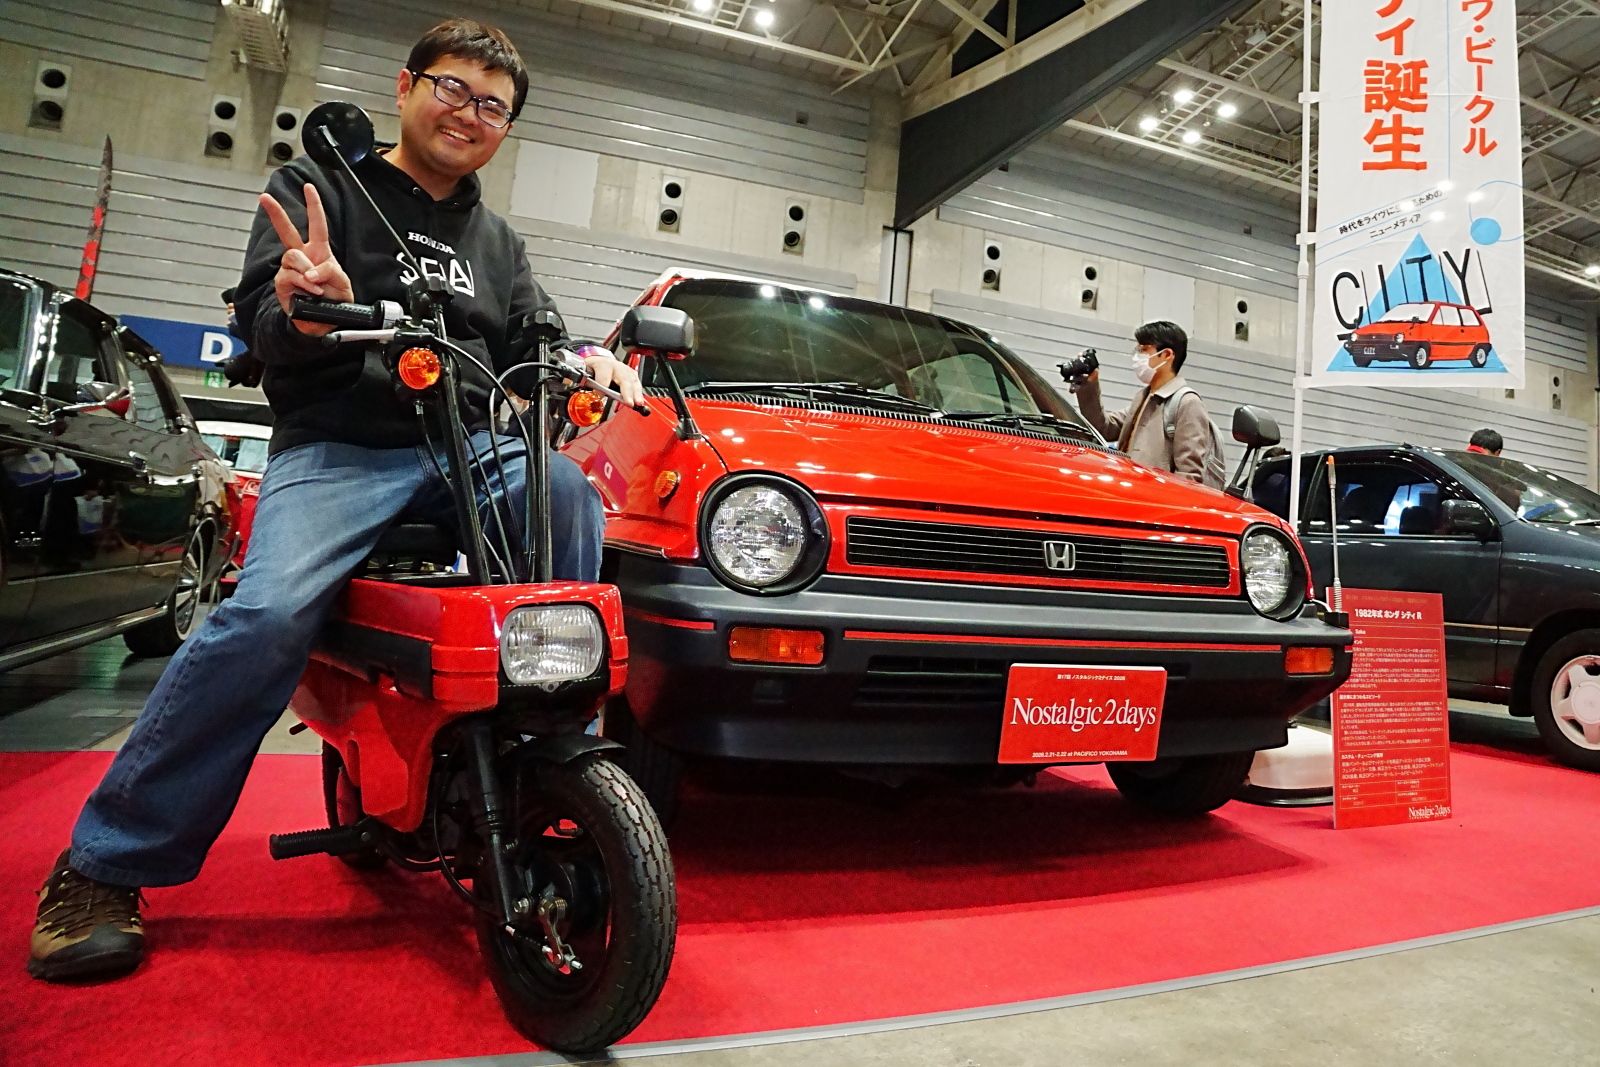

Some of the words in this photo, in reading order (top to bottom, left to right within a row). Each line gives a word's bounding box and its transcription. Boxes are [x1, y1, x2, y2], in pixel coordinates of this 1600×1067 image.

[1369, 213, 1421, 239] ニューメディア
[407, 231, 456, 254] HONDA
[1332, 248, 1492, 333] CITY
[200, 331, 233, 362] D
[1383, 609, 1400, 620] ホンダ
[1401, 610, 1416, 620] シティ
[1010, 697, 1102, 732] Nostalgic
[1103, 698, 1156, 732] 2days
[1408, 806, 1435, 818] Nostalgic
[1435, 804, 1451, 817] 2days
